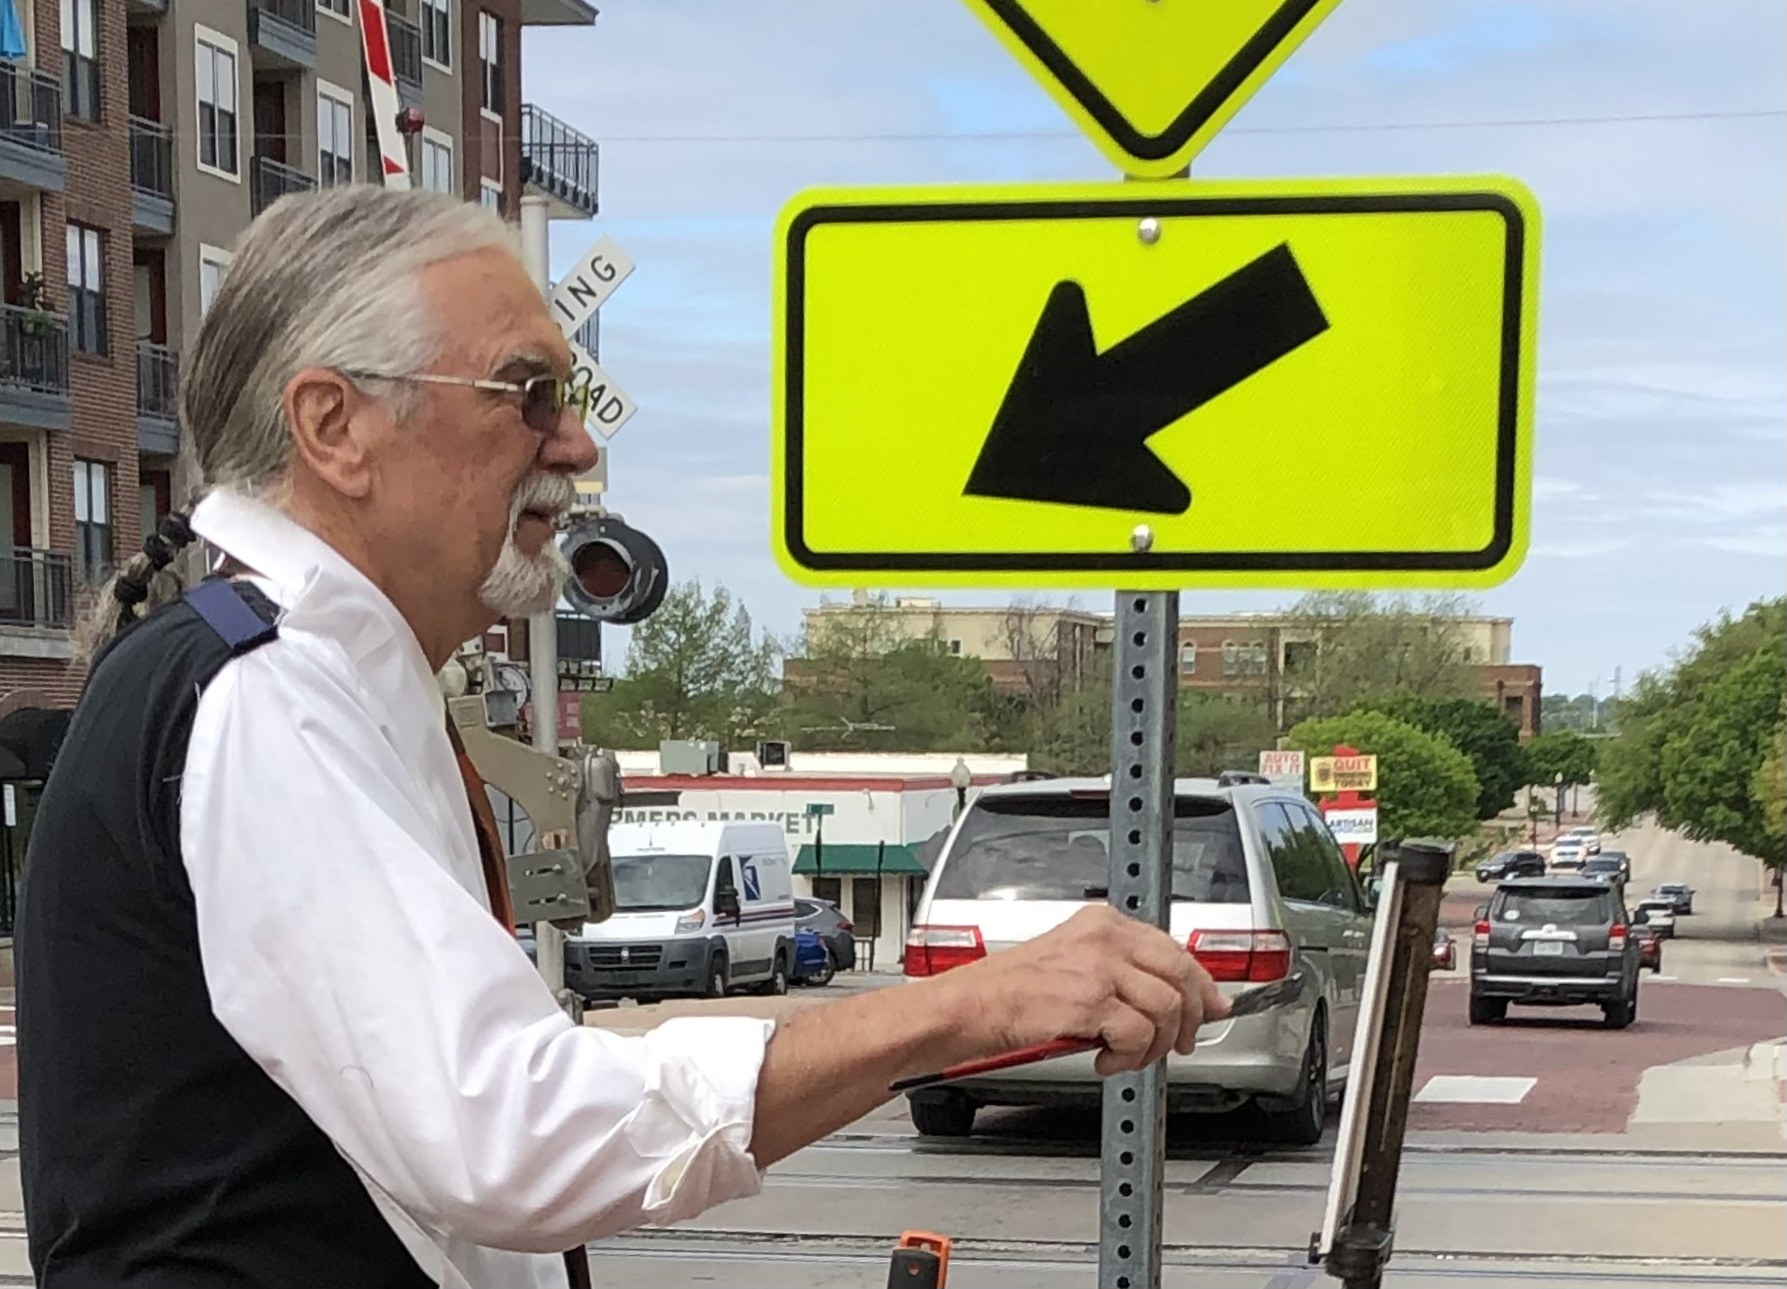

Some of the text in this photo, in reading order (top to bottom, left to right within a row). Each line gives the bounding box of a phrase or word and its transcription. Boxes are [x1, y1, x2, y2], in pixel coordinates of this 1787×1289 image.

[554, 254, 617, 323] ING
[1264, 753, 1300, 763] AUTO
[1333, 758, 1371, 770] QUIT
